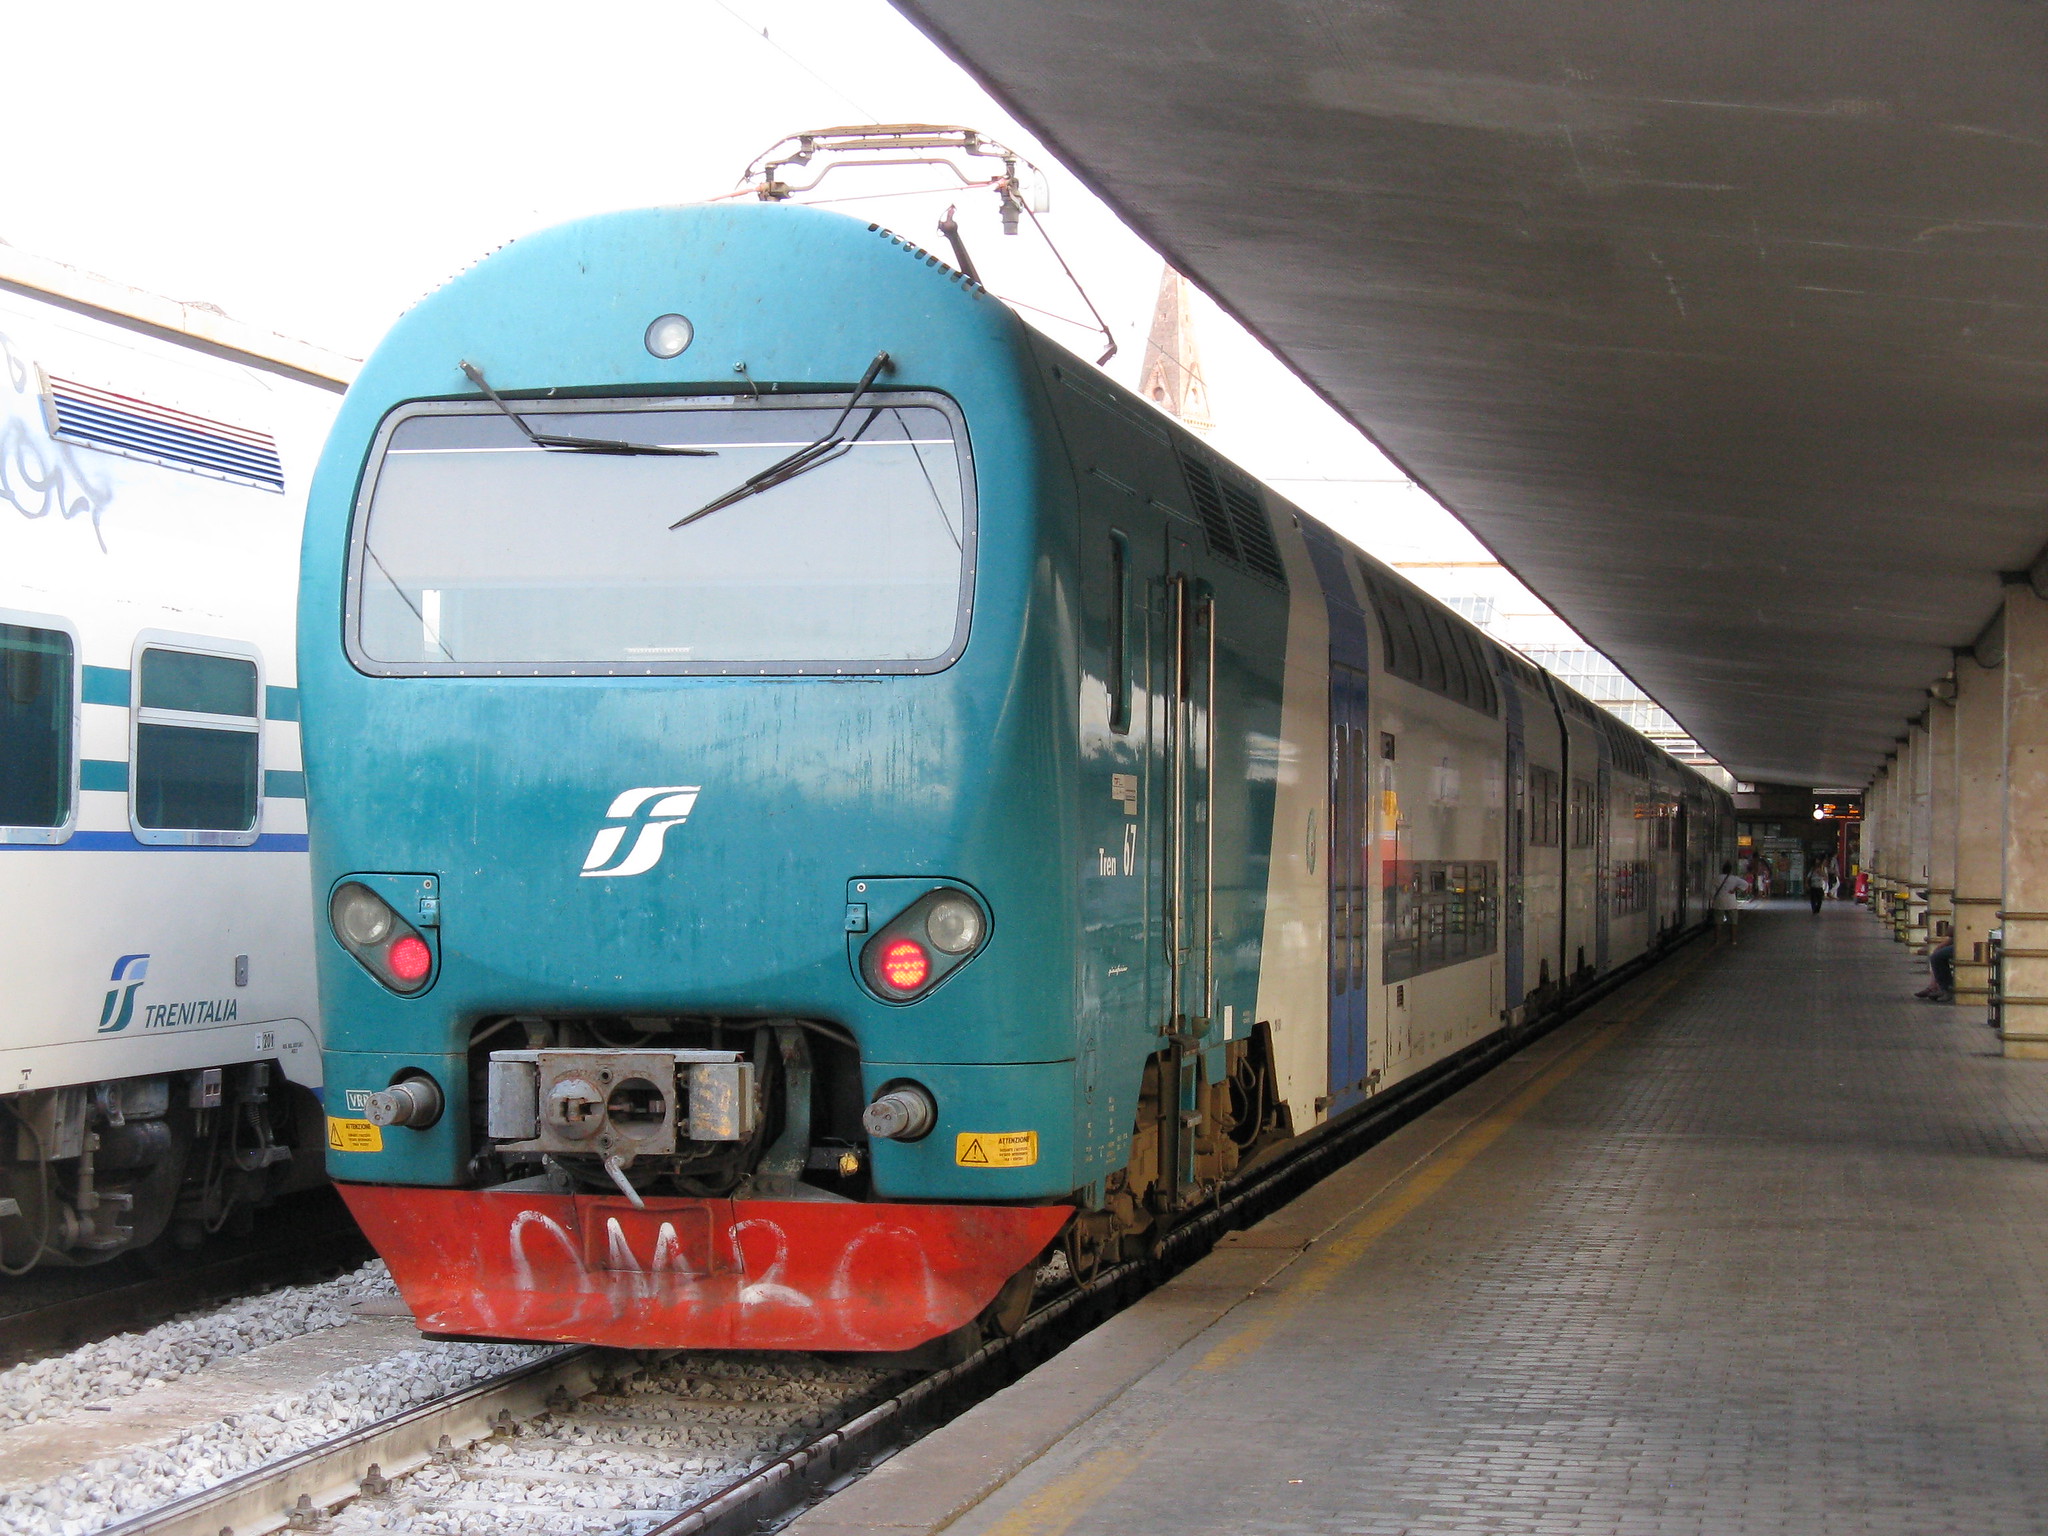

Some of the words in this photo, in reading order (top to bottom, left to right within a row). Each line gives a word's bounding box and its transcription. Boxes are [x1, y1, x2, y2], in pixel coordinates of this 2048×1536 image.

[1099, 848, 1117, 876] Tren
[1123, 823, 1137, 876] 67
[145, 998, 237, 1028] TRENITALIA
